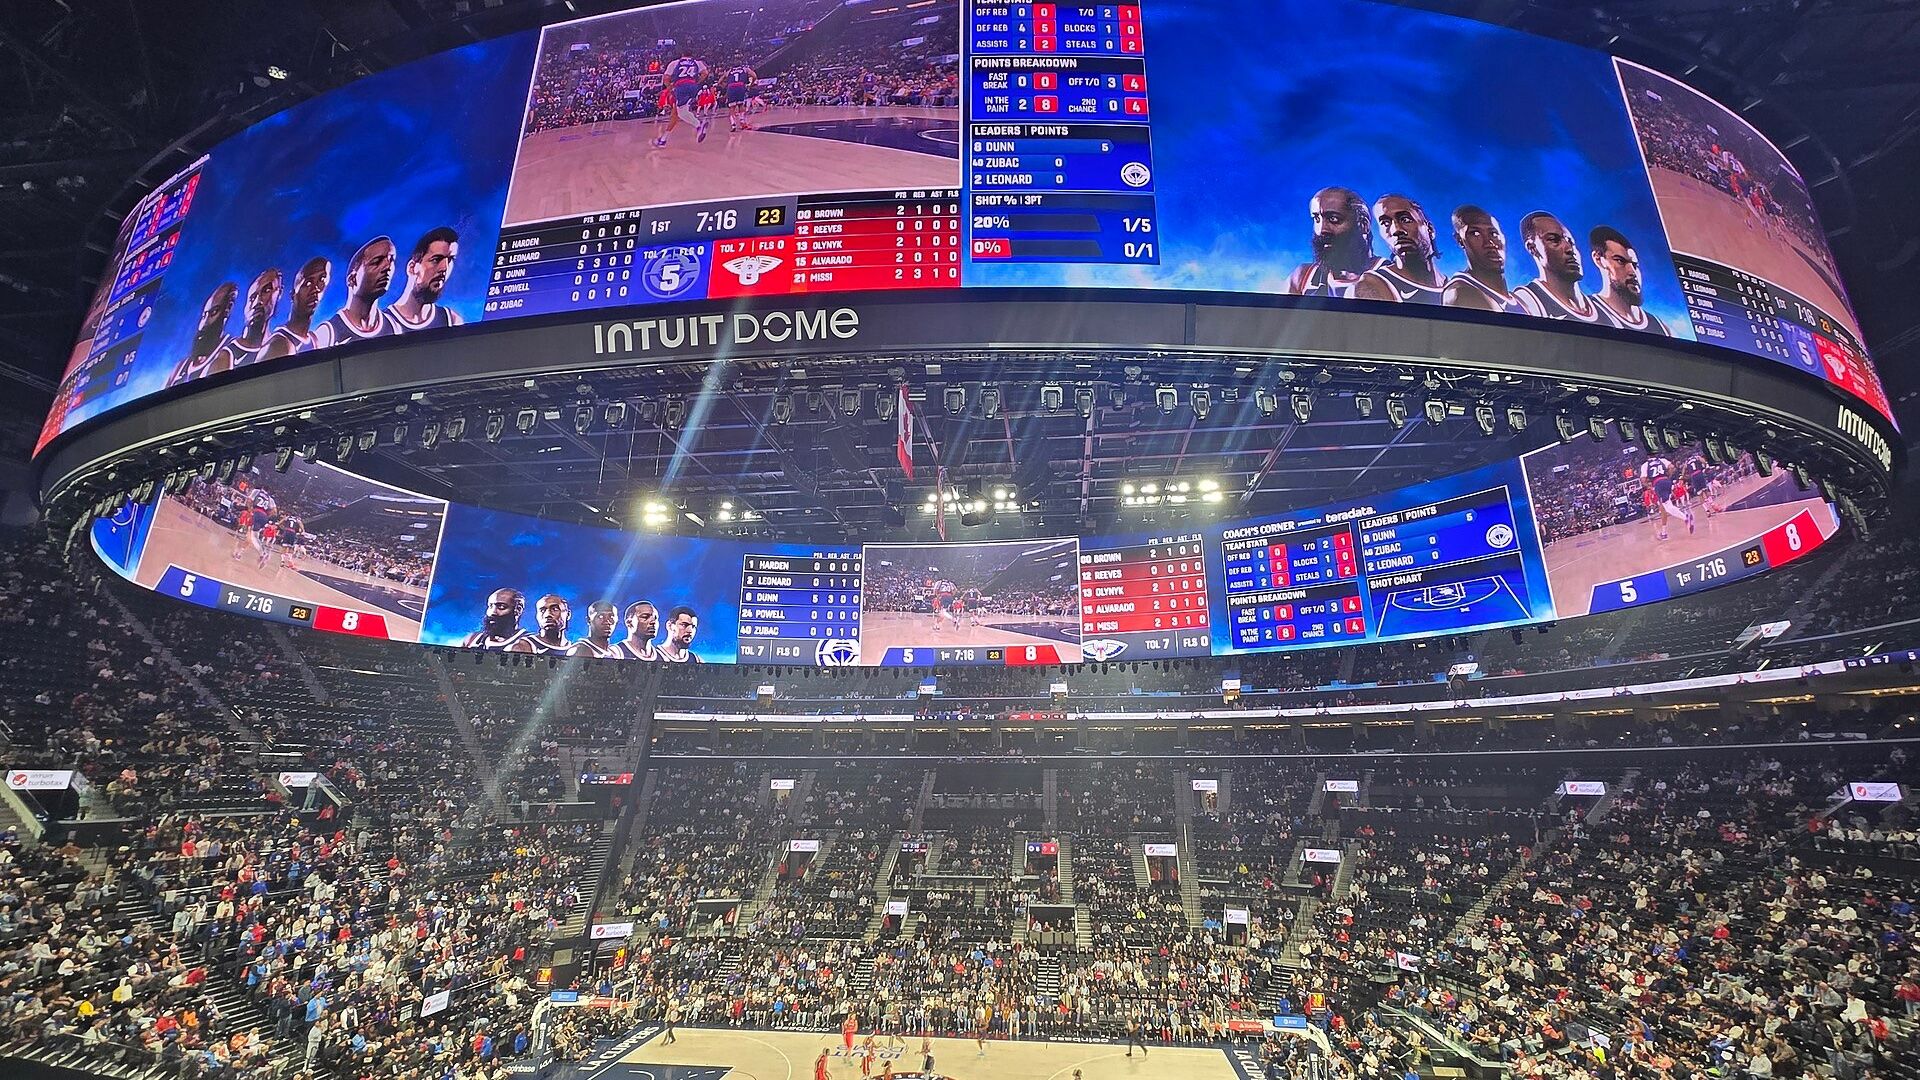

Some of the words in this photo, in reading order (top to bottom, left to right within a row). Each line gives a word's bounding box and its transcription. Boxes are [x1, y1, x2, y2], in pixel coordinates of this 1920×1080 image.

[1019, 8, 1025, 16] 0
[1041, 8, 1048, 16] 0
[1104, 9, 1111, 17] 2
[1127, 10, 1132, 18] 1
[1064, 25, 1095, 33] BLOCKS
[1106, 25, 1111, 33] 1
[1128, 26, 1134, 34] 0
[1019, 40, 1026, 48] 2
[1042, 40, 1049, 48] 2
[1106, 41, 1113, 49] 0
[1129, 42, 1135, 50] 2
[975, 59, 1011, 68] POINTS
[1013, 59, 1077, 68] BREAKDOWN
[678, 66, 694, 77] 24
[1018, 77, 1027, 86] 0
[1041, 77, 1049, 86] 0
[1068, 78, 1085, 86] OFF
[1108, 78, 1116, 88] 3
[1131, 79, 1139, 88] 4
[1019, 100, 1027, 109] 2
[1042, 100, 1050, 110] 8
[1109, 100, 1118, 110] 0
[1132, 102, 1140, 112] 4
[975, 126, 1020, 135] LEADERS
[1031, 127, 1068, 135] POINTS
[974, 142, 982, 151] 8
[986, 142, 1014, 151] DUNN
[1102, 143, 1108, 151] 5
[986, 158, 1019, 168] ZUBAC
[1055, 158, 1062, 167] 0
[974, 175, 982, 184] 2
[986, 175, 1032, 184] LEONARD
[1056, 175, 1063, 183] 0
[975, 196, 1002, 205] SHOT
[1004, 196, 1017, 204] %
[1025, 196, 1042, 205] 3PT
[759, 209, 780, 224] 23
[797, 210, 811, 219] 00
[814, 209, 843, 218] BROWN
[696, 210, 737, 232] 7:16
[974, 216, 1009, 228] 20%
[1123, 218, 1151, 232] 1/5
[651, 221, 671, 234] 1ST
[797, 226, 809, 235] 12
[814, 225, 842, 234] REEVES
[502, 242, 507, 250] 1
[512, 238, 539, 249] HARDEN
[720, 244, 735, 253] TOL
[738, 243, 745, 251] 7
[759, 241, 774, 250] FLS
[778, 240, 784, 249] 0
[796, 242, 807, 251] 13
[813, 240, 842, 250] OLYNYK
[974, 241, 1001, 253] 0%
[1124, 243, 1152, 257] 0/1
[644, 250, 657, 259] TOL
[698, 246, 704, 255] 0
[497, 257, 504, 265] 2
[509, 252, 540, 263] LEONARD
[795, 257, 806, 266] 15
[812, 256, 852, 266] ALVARADO
[494, 271, 501, 280] 8
[506, 269, 526, 279] DUNN
[659, 264, 680, 291] 5
[794, 274, 805, 283] 21
[810, 273, 832, 282] MISSI
[489, 286, 500, 296] 24
[503, 283, 530, 294] POWELL
[485, 302, 497, 312] 40
[500, 299, 523, 309] ZUBAC
[1794, 302, 1816, 326] 7:16
[594, 315, 723, 354] INTUIT
[734, 308, 859, 343] DOME
[1797, 341, 1812, 365] 5
[1650, 465, 1664, 477] 24
[1362, 515, 1398, 529] LEADERS
[1406, 506, 1437, 520] POINTS
[1223, 527, 1258, 539] COACH'S
[1260, 521, 1295, 533] CORNER
[1373, 529, 1395, 542] DUNN
[1785, 523, 1801, 550] 8
[1226, 542, 1246, 551] TEAM
[1246, 539, 1268, 548] STATS
[1374, 543, 1401, 555] ZUBAC
[760, 561, 789, 570] HARDEN
[1377, 556, 1413, 569] LEONARD
[1095, 570, 1122, 579] REEVES
[1620, 580, 1637, 602] 5
[1676, 571, 1691, 586] 1ST
[1696, 558, 1727, 581] 7:16
[1746, 550, 1759, 564] 23
[758, 577, 792, 587] LEONARD
[1370, 578, 1394, 589] SHOT
[1394, 573, 1422, 584] CHART
[1096, 586, 1124, 596] OLYNYK
[180, 574, 196, 597] 5
[227, 592, 240, 604] 1ST
[244, 594, 273, 613] 7:16
[293, 607, 307, 619] 23
[342, 612, 358, 630] 8
[757, 593, 778, 602] DUNN
[1230, 596, 1256, 605] POINTS
[1258, 590, 1306, 602] BREAKDOWN
[1096, 603, 1134, 613] ALVARADO
[756, 609, 785, 619] POWELL
[754, 626, 779, 635] ZUBAC
[1097, 621, 1118, 630] MISSI
[903, 649, 913, 663] 5
[989, 651, 999, 659] 23
[1025, 646, 1037, 661] 8
[578, 1059, 608, 1071] LA
[599, 1026, 660, 1061] CLIPPERS
